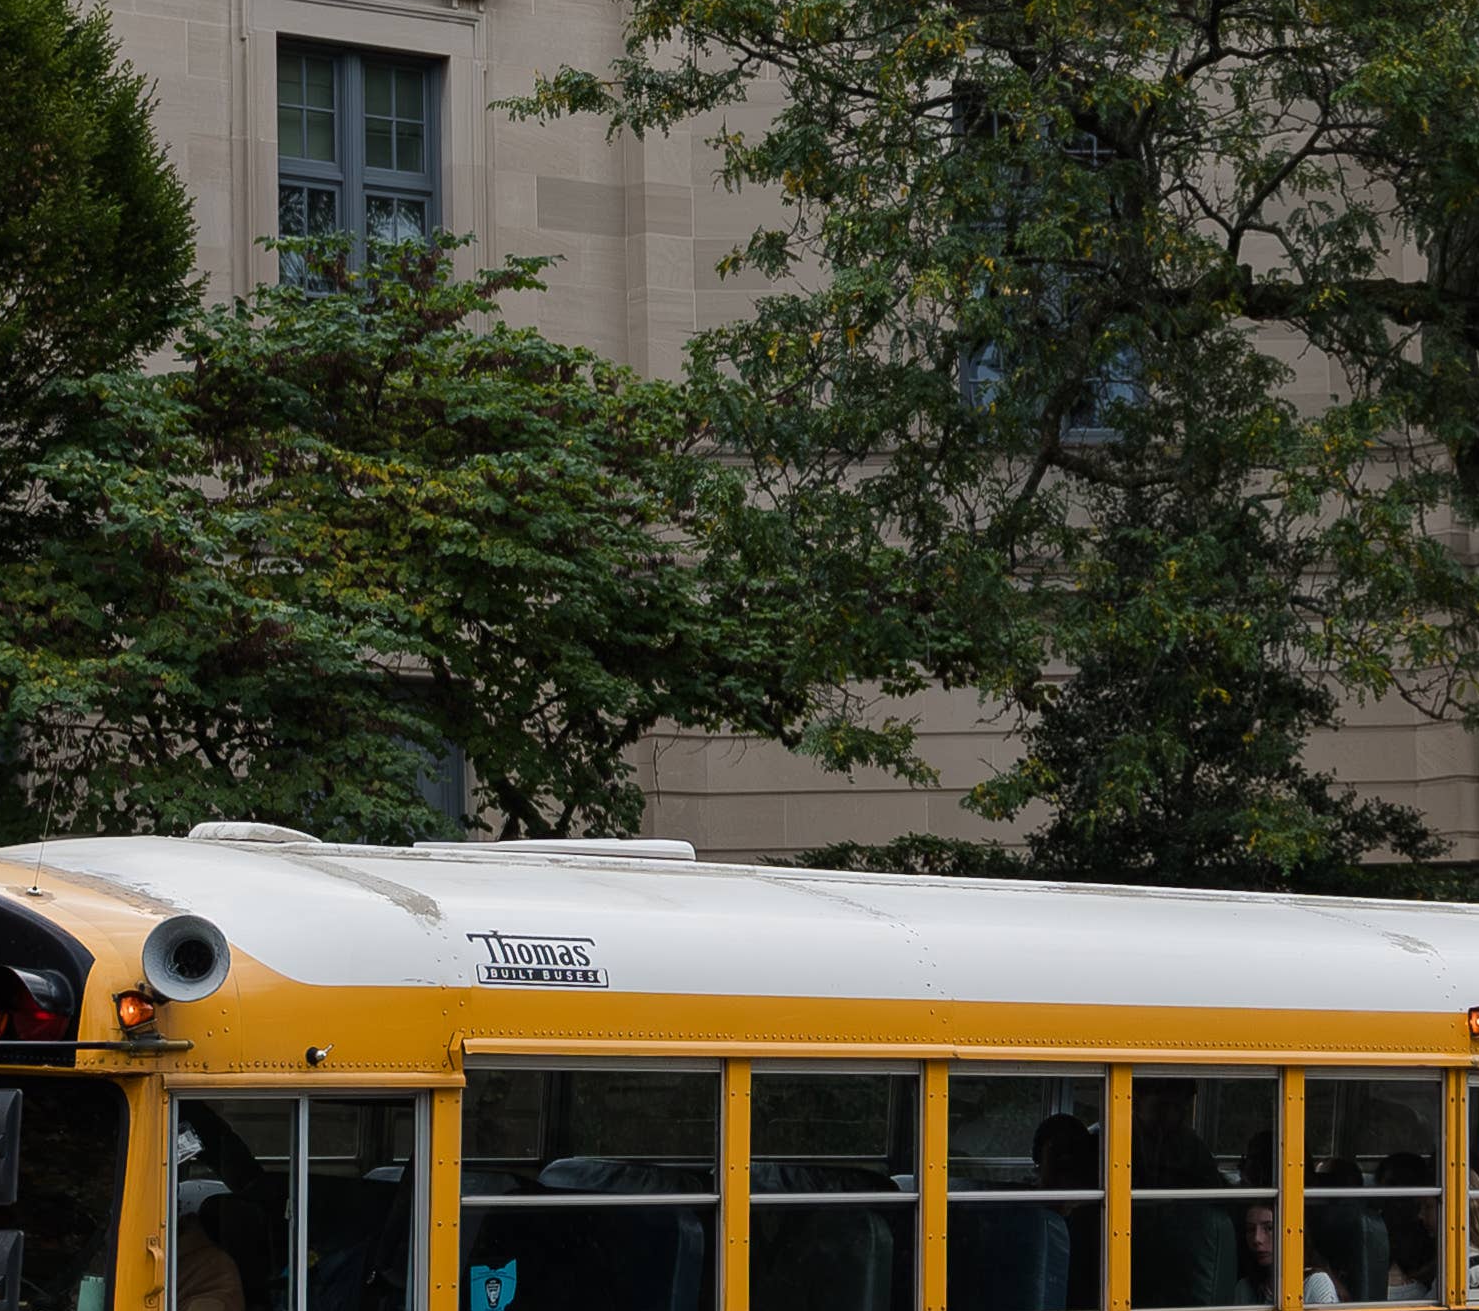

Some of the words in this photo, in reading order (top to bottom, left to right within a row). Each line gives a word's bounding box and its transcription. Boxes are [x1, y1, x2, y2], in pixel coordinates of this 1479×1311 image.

[466, 930, 595, 967] Thomas
[490, 968, 534, 979] BUILT
[542, 969, 597, 982] BUSES
